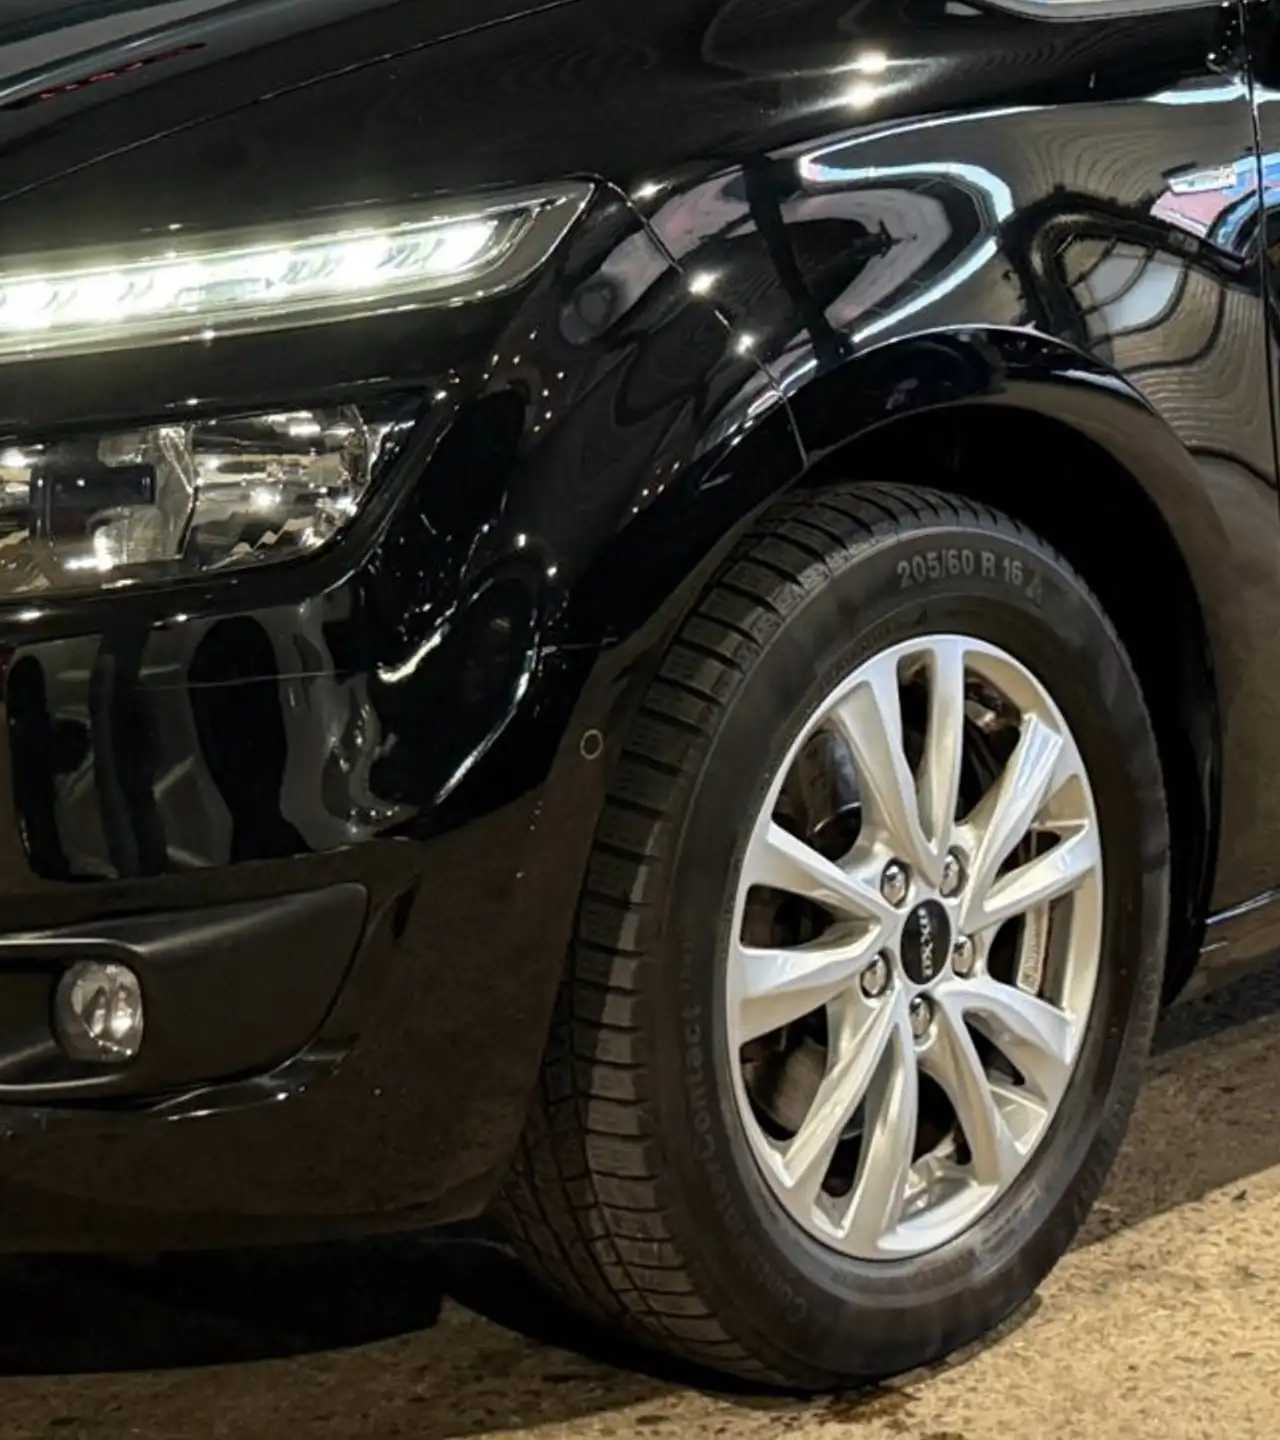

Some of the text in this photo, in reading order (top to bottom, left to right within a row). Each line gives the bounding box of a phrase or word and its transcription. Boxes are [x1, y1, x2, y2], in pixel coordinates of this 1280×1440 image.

[896, 548, 1025, 590] 205/60 R 16
